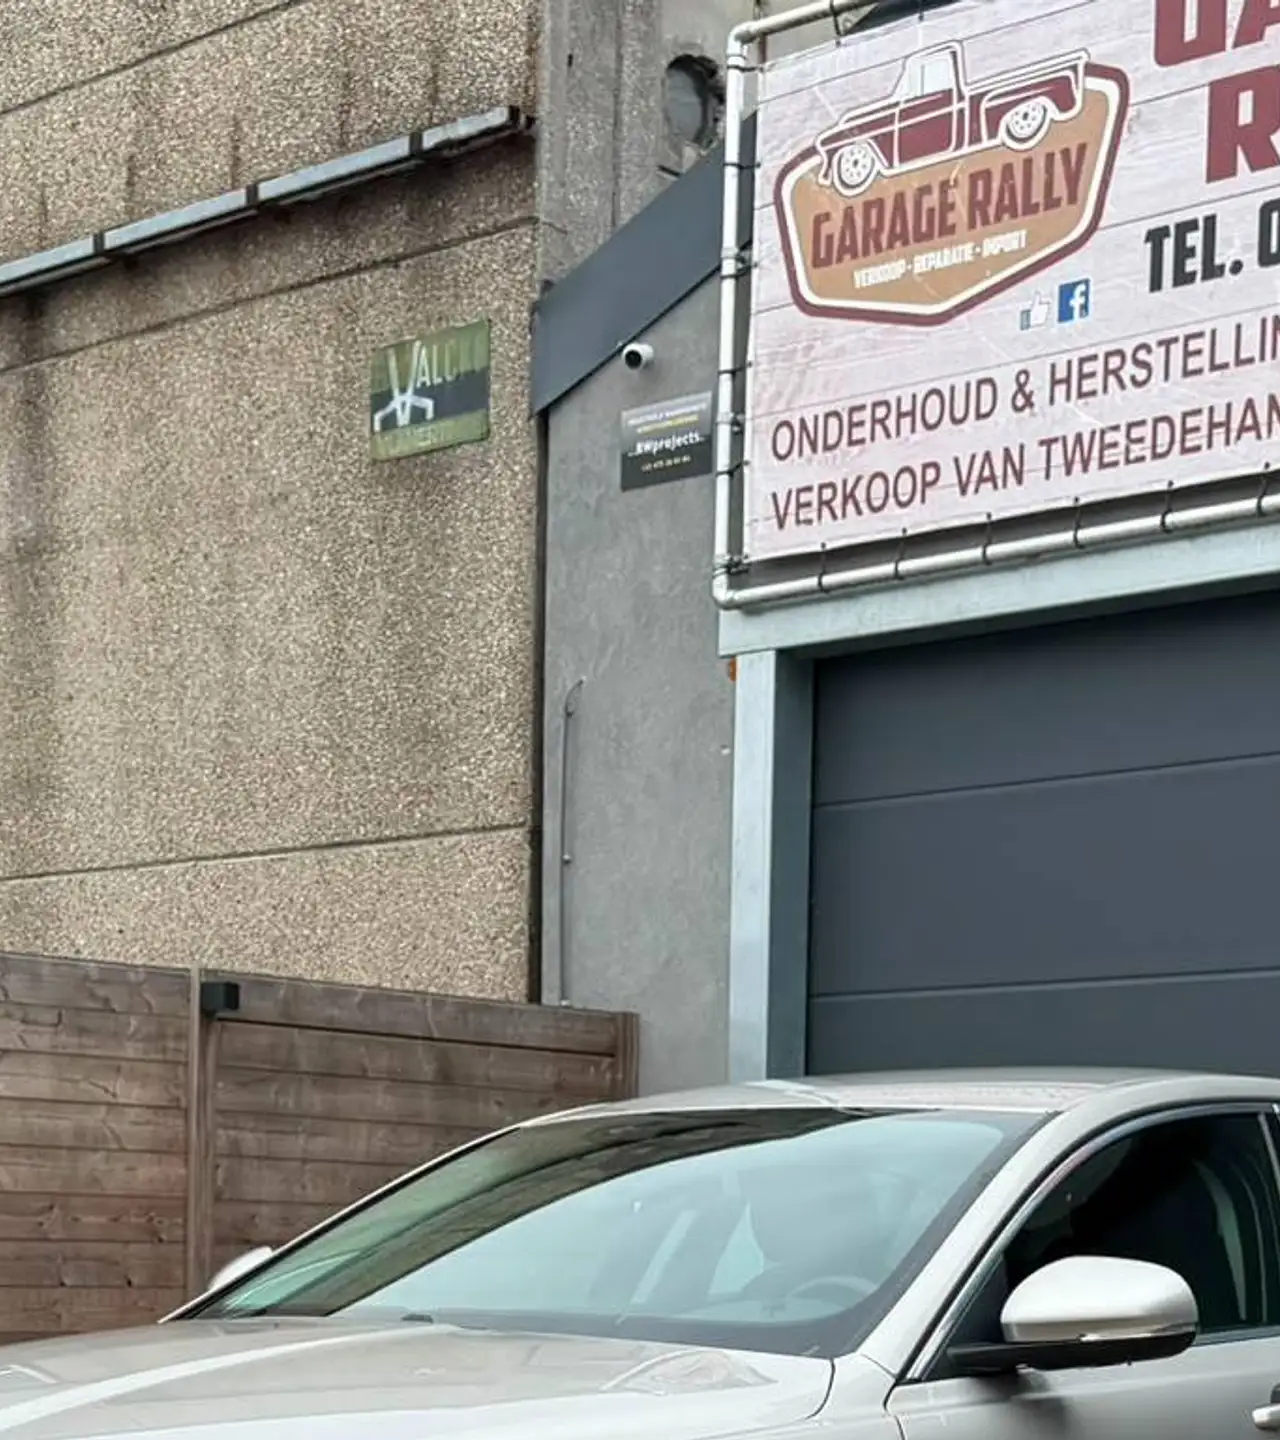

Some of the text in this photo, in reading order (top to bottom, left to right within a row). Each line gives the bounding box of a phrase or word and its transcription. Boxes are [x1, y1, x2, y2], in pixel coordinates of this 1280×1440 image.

[811, 143, 1088, 270] GARAGE RALLY
[1144, 214, 1244, 293] TEL.
[771, 376, 998, 462] ONDERHOUD
[1011, 368, 1036, 414] &
[771, 460, 942, 531] VERKOOP
[953, 443, 1026, 497] VAN
